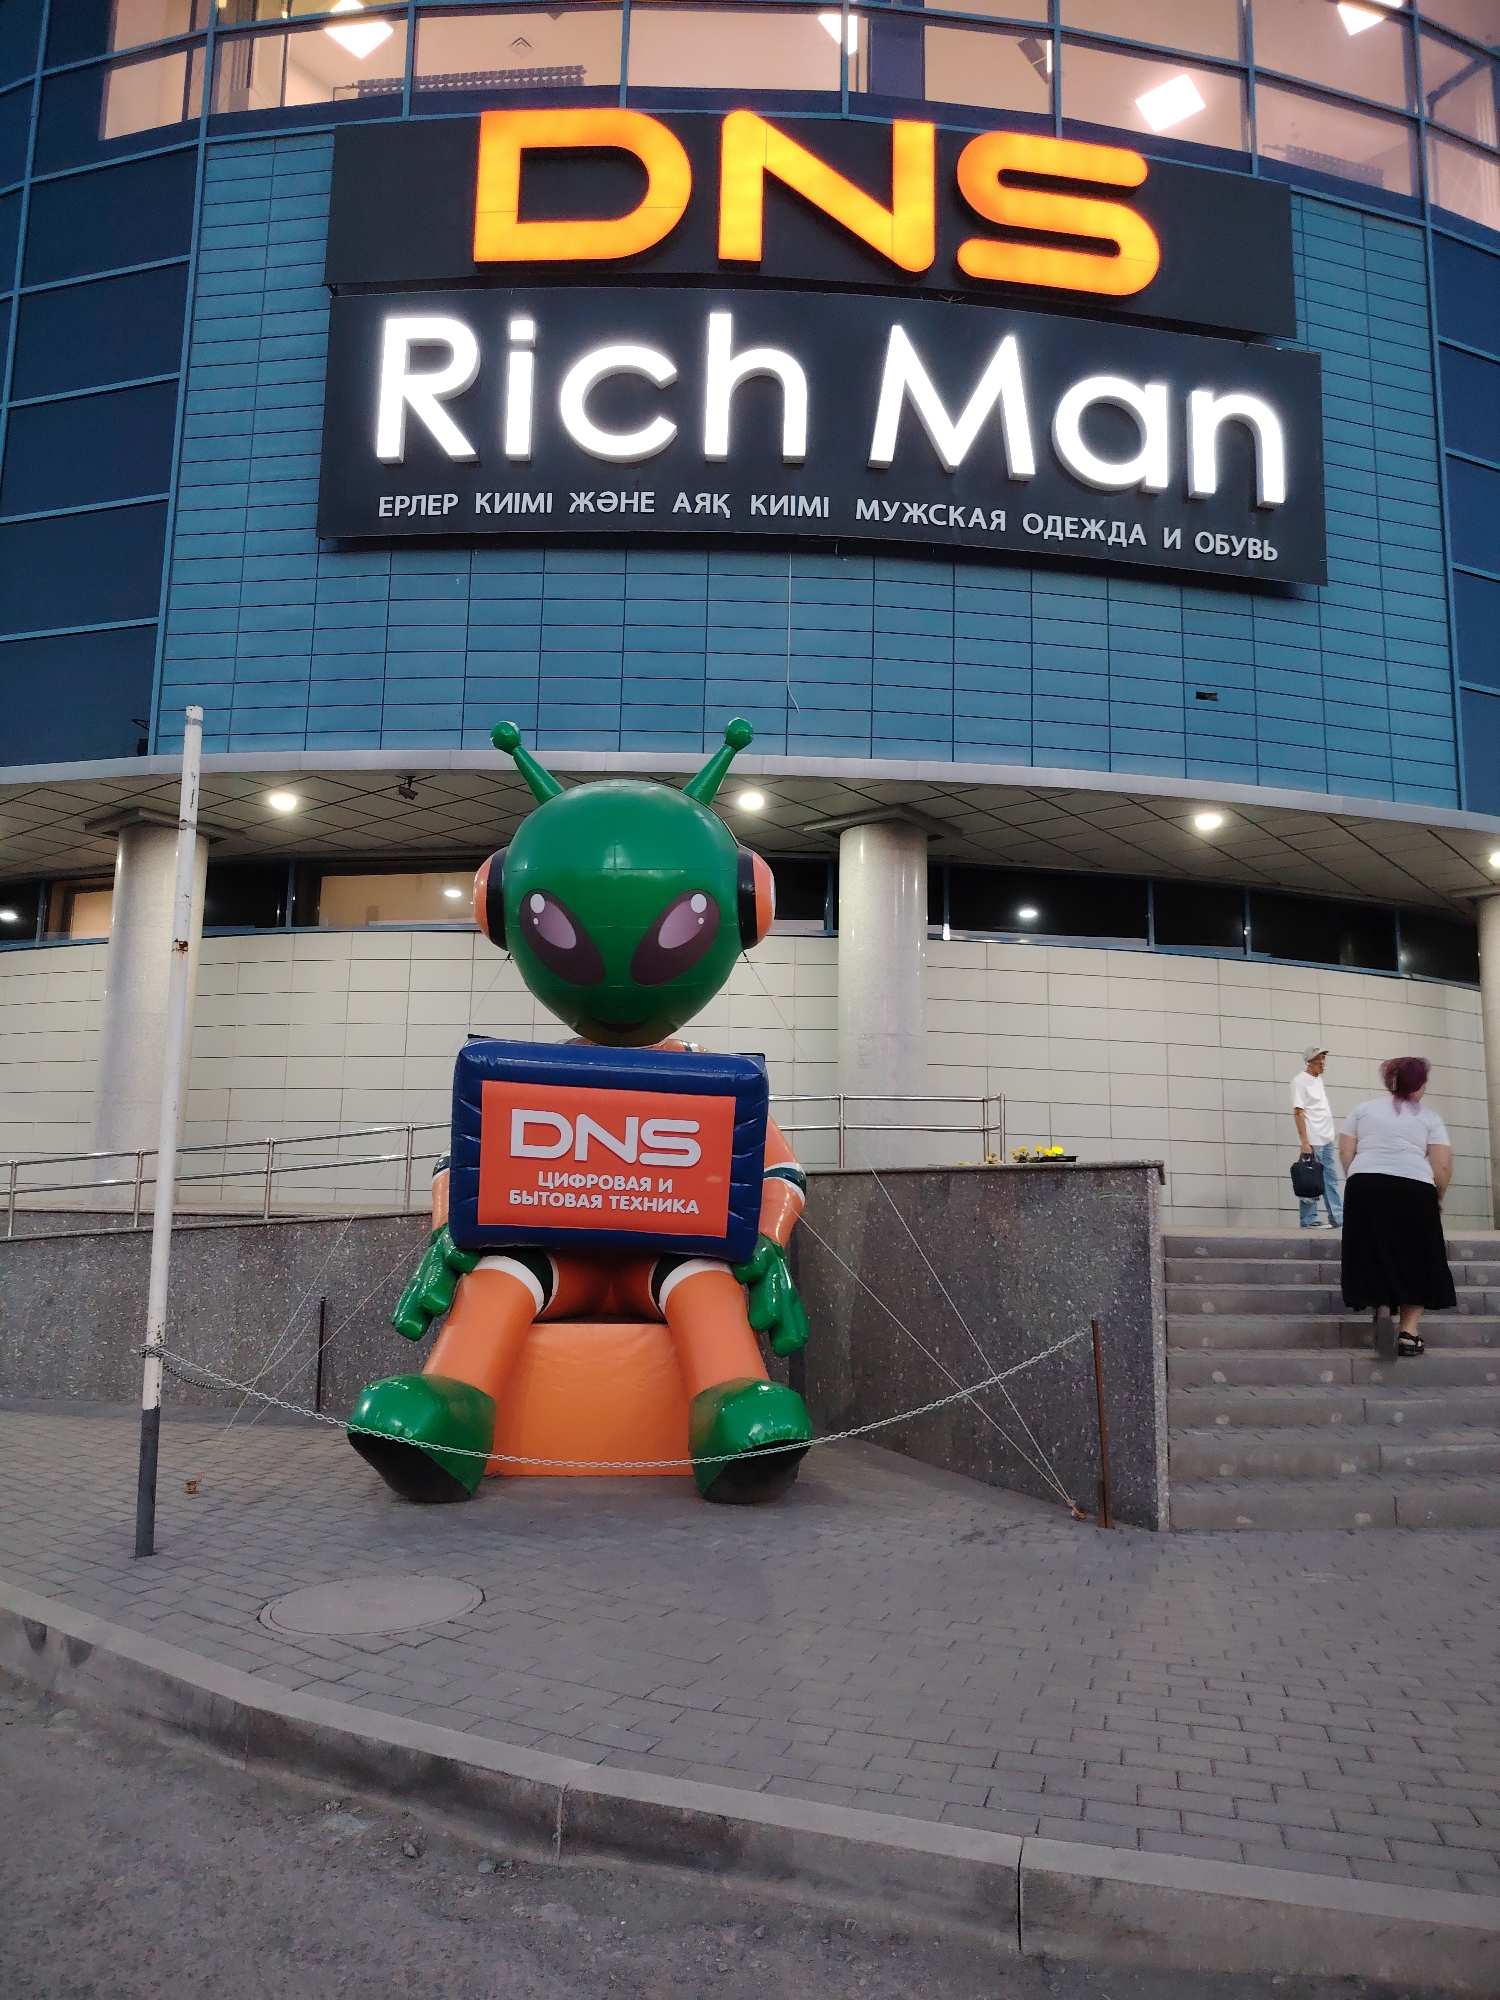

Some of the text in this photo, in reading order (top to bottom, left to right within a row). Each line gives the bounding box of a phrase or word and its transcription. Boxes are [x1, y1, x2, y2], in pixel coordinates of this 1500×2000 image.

[473, 108, 1160, 296] DNS
[375, 311, 1286, 508] Rich Man
[378, 491, 1279, 562] ЕРЛЕР КИІМІ ЖӘНЕ АЯҚ КИІМІ МУЖСКАЯ ОДЕЖДА И ОБУВЬ
[510, 1108, 702, 1168] DNS
[509, 1189, 699, 1215] БЫТОВАЯ ТЕХНИКА
[538, 1170, 673, 1194] ЦИФРОВАЯ И
